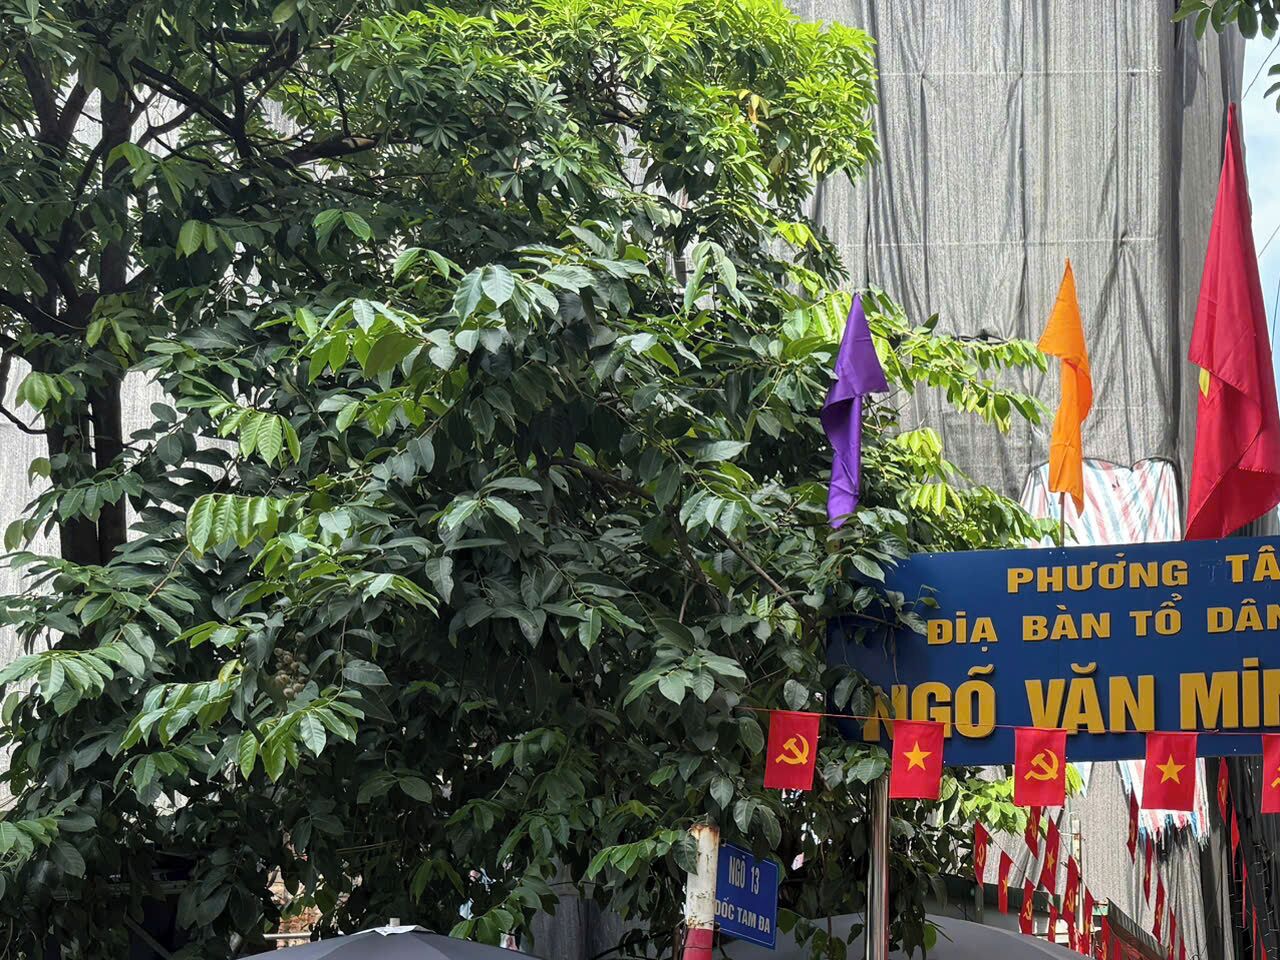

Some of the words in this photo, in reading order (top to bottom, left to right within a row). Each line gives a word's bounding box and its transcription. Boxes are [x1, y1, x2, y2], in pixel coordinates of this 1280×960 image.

[1022, 604, 1111, 641] BÀN
[1130, 593, 1182, 636] TỔ
[863, 664, 996, 742] NGÕ
[1025, 661, 1155, 735] VĂN
[751, 866, 760, 895] 13
[714, 897, 735, 920] DỐC
[737, 907, 757, 929] TAM
